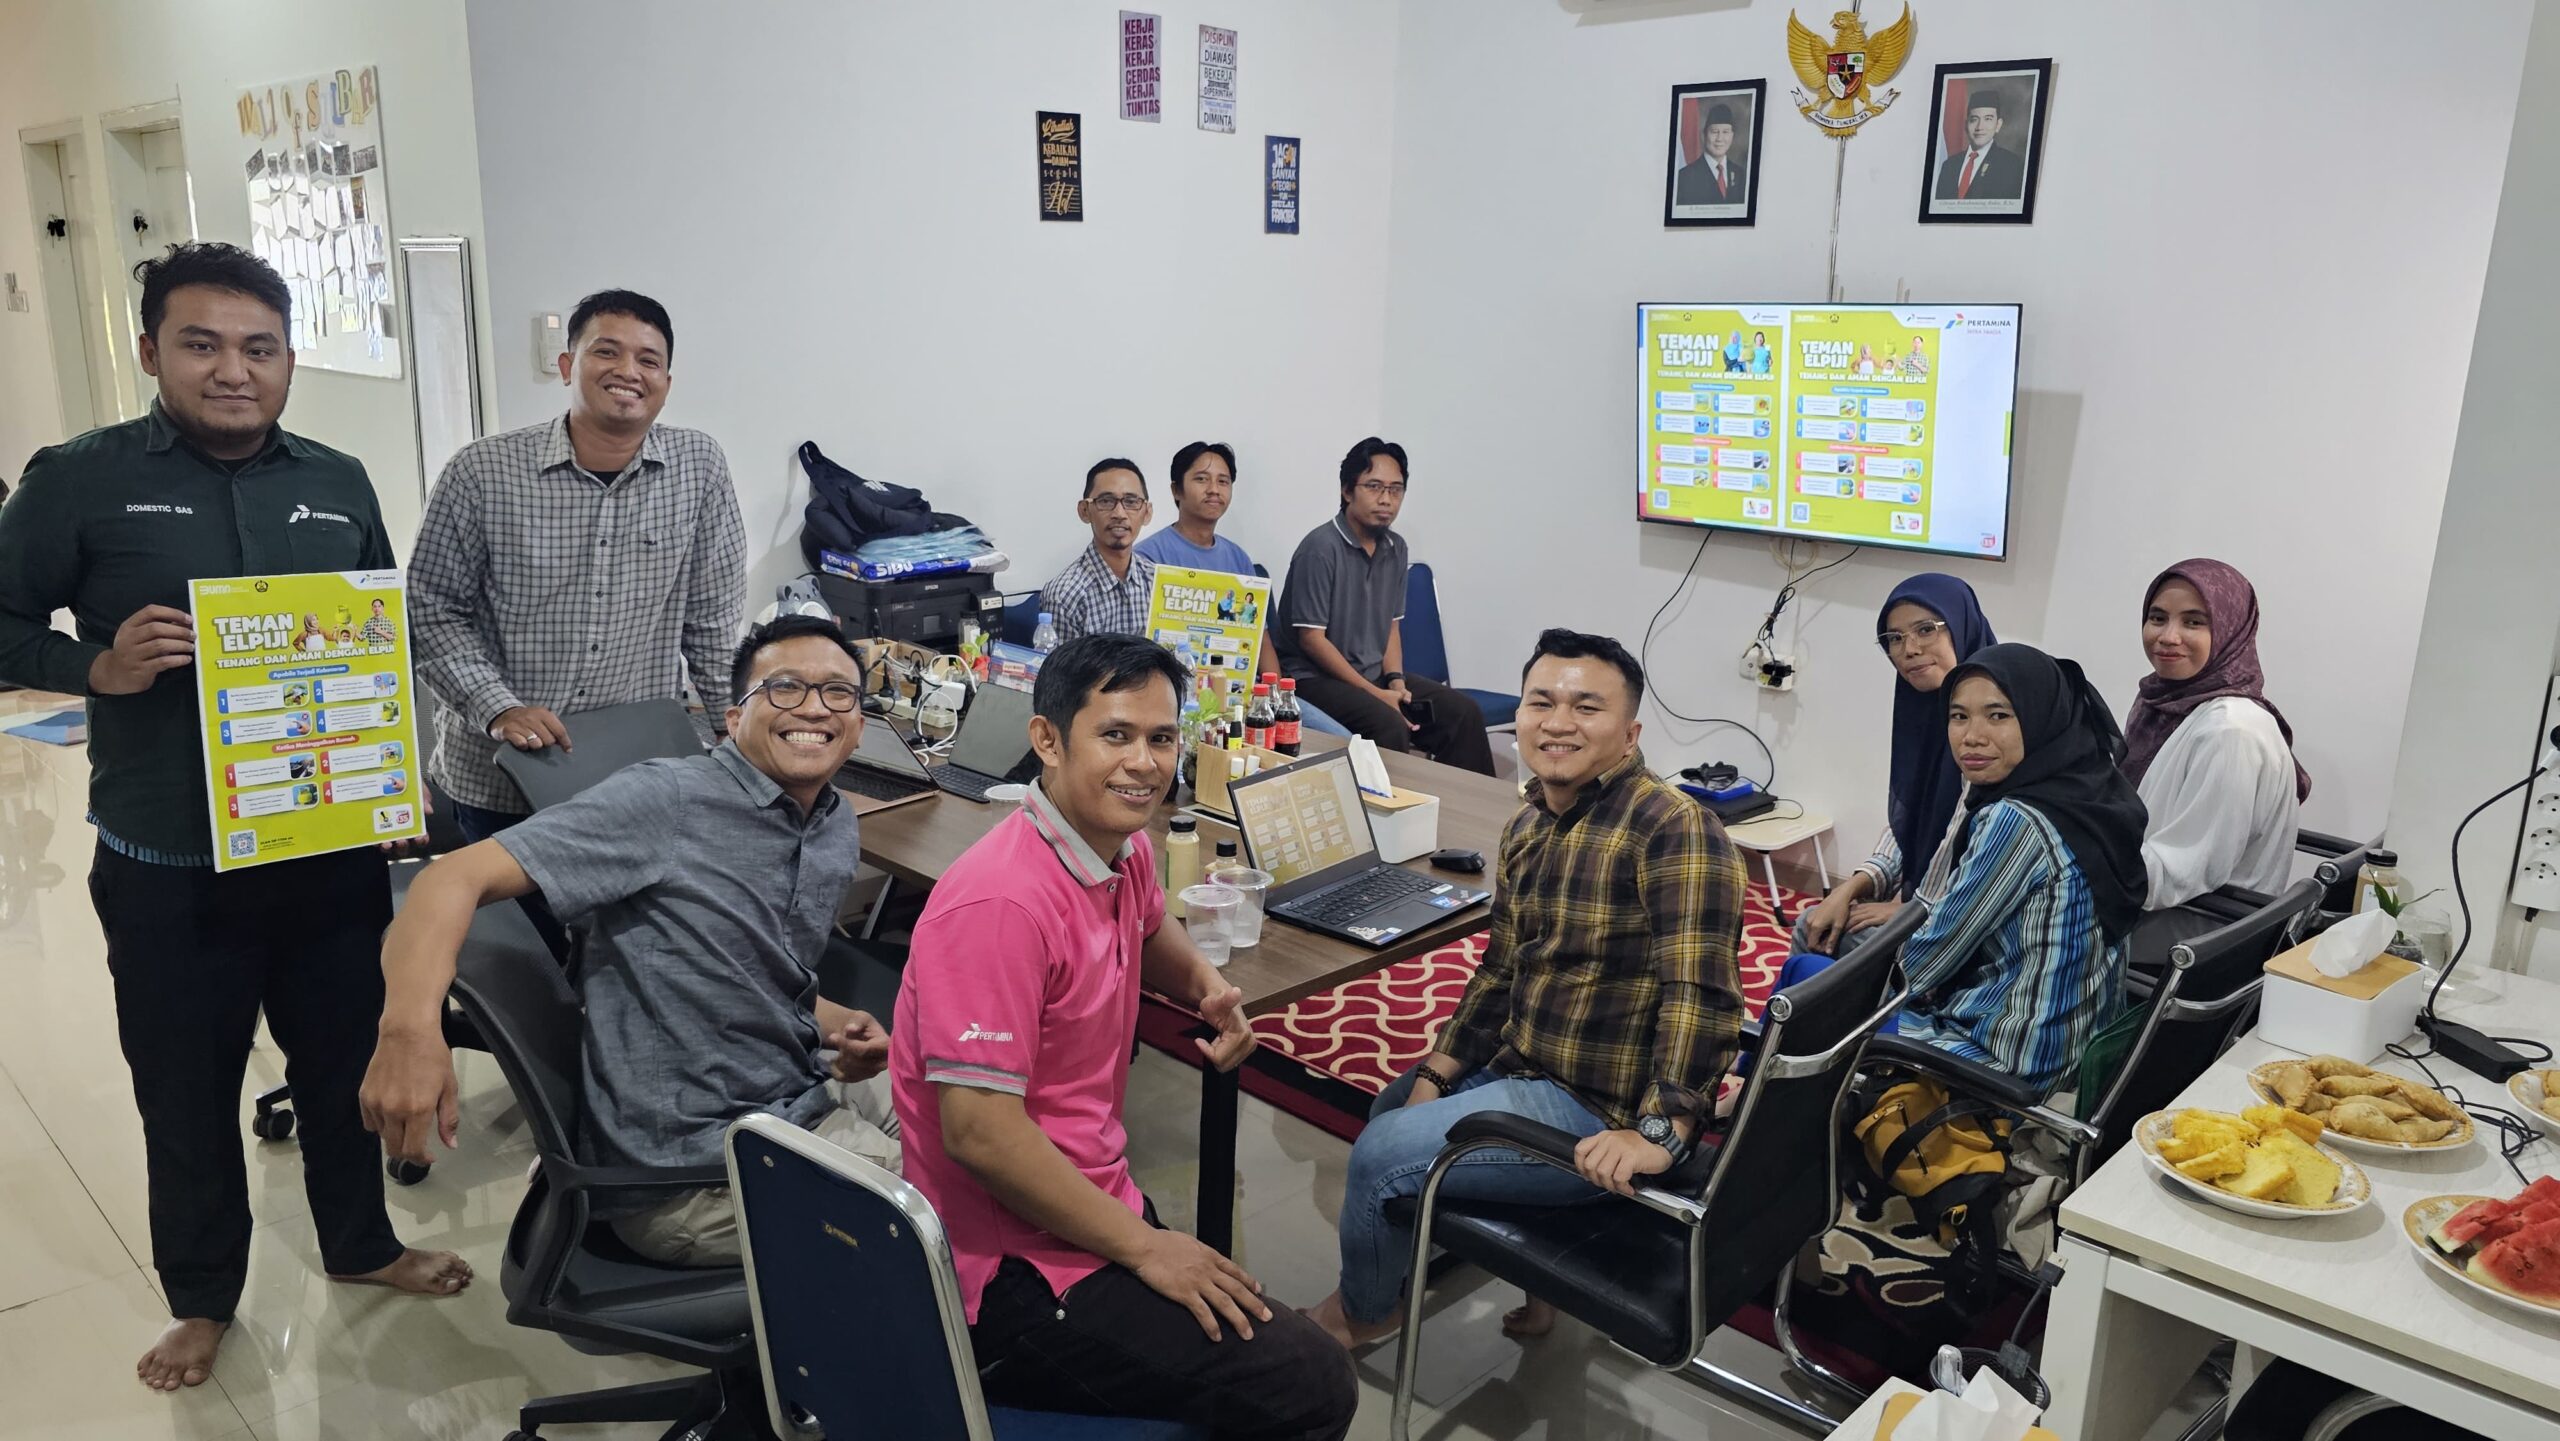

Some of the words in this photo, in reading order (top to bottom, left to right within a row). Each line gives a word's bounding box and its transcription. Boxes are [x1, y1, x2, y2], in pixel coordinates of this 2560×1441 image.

[1125, 18, 1154, 35] KERJA
[1125, 35, 1154, 52] KERAS
[1204, 31, 1234, 47] DISIPLIN
[1125, 51, 1154, 68] KERJA
[1204, 50, 1234, 65] DIAWASI
[1125, 67, 1160, 85] CERDAS
[1204, 67, 1233, 82] BEKERJA
[1126, 83, 1154, 100] KERJA
[1204, 87, 1233, 99] DIPERINTAH
[1126, 99, 1160, 117] TUNTAS
[1203, 112, 1233, 128] DIMINTA
[1043, 143, 1077, 157] KEBAIKAN
[1272, 168, 1296, 180] BANYAK
[1967, 319, 2011, 327] PERTAMINA
[1658, 333, 1719, 350] TEMAN
[1800, 341, 1853, 355] TEMAN
[1662, 350, 1713, 367] ELPIJI
[1804, 354, 1848, 368] ELPIJI
[126, 504, 171, 513] DOMESTIC
[175, 506, 193, 515] GAS
[312, 512, 350, 523] PERTAMINA
[1162, 584, 1217, 603] TEMAN
[1165, 598, 1210, 614] ELPIJI
[213, 613, 295, 635] TEMAN
[223, 631, 289, 652] ELPIJI
[217, 656, 261, 669] TENANG
[264, 654, 287, 664] DAN
[290, 651, 322, 662] AMAN
[324, 648, 366, 660] DENGAN
[368, 645, 395, 655] ELPIJI
[273, 671, 296, 679] Apabila
[297, 668, 315, 676] Terjadi
[276, 743, 295, 751] Ketika
[979, 1031, 1013, 1043] PERTAMINA
